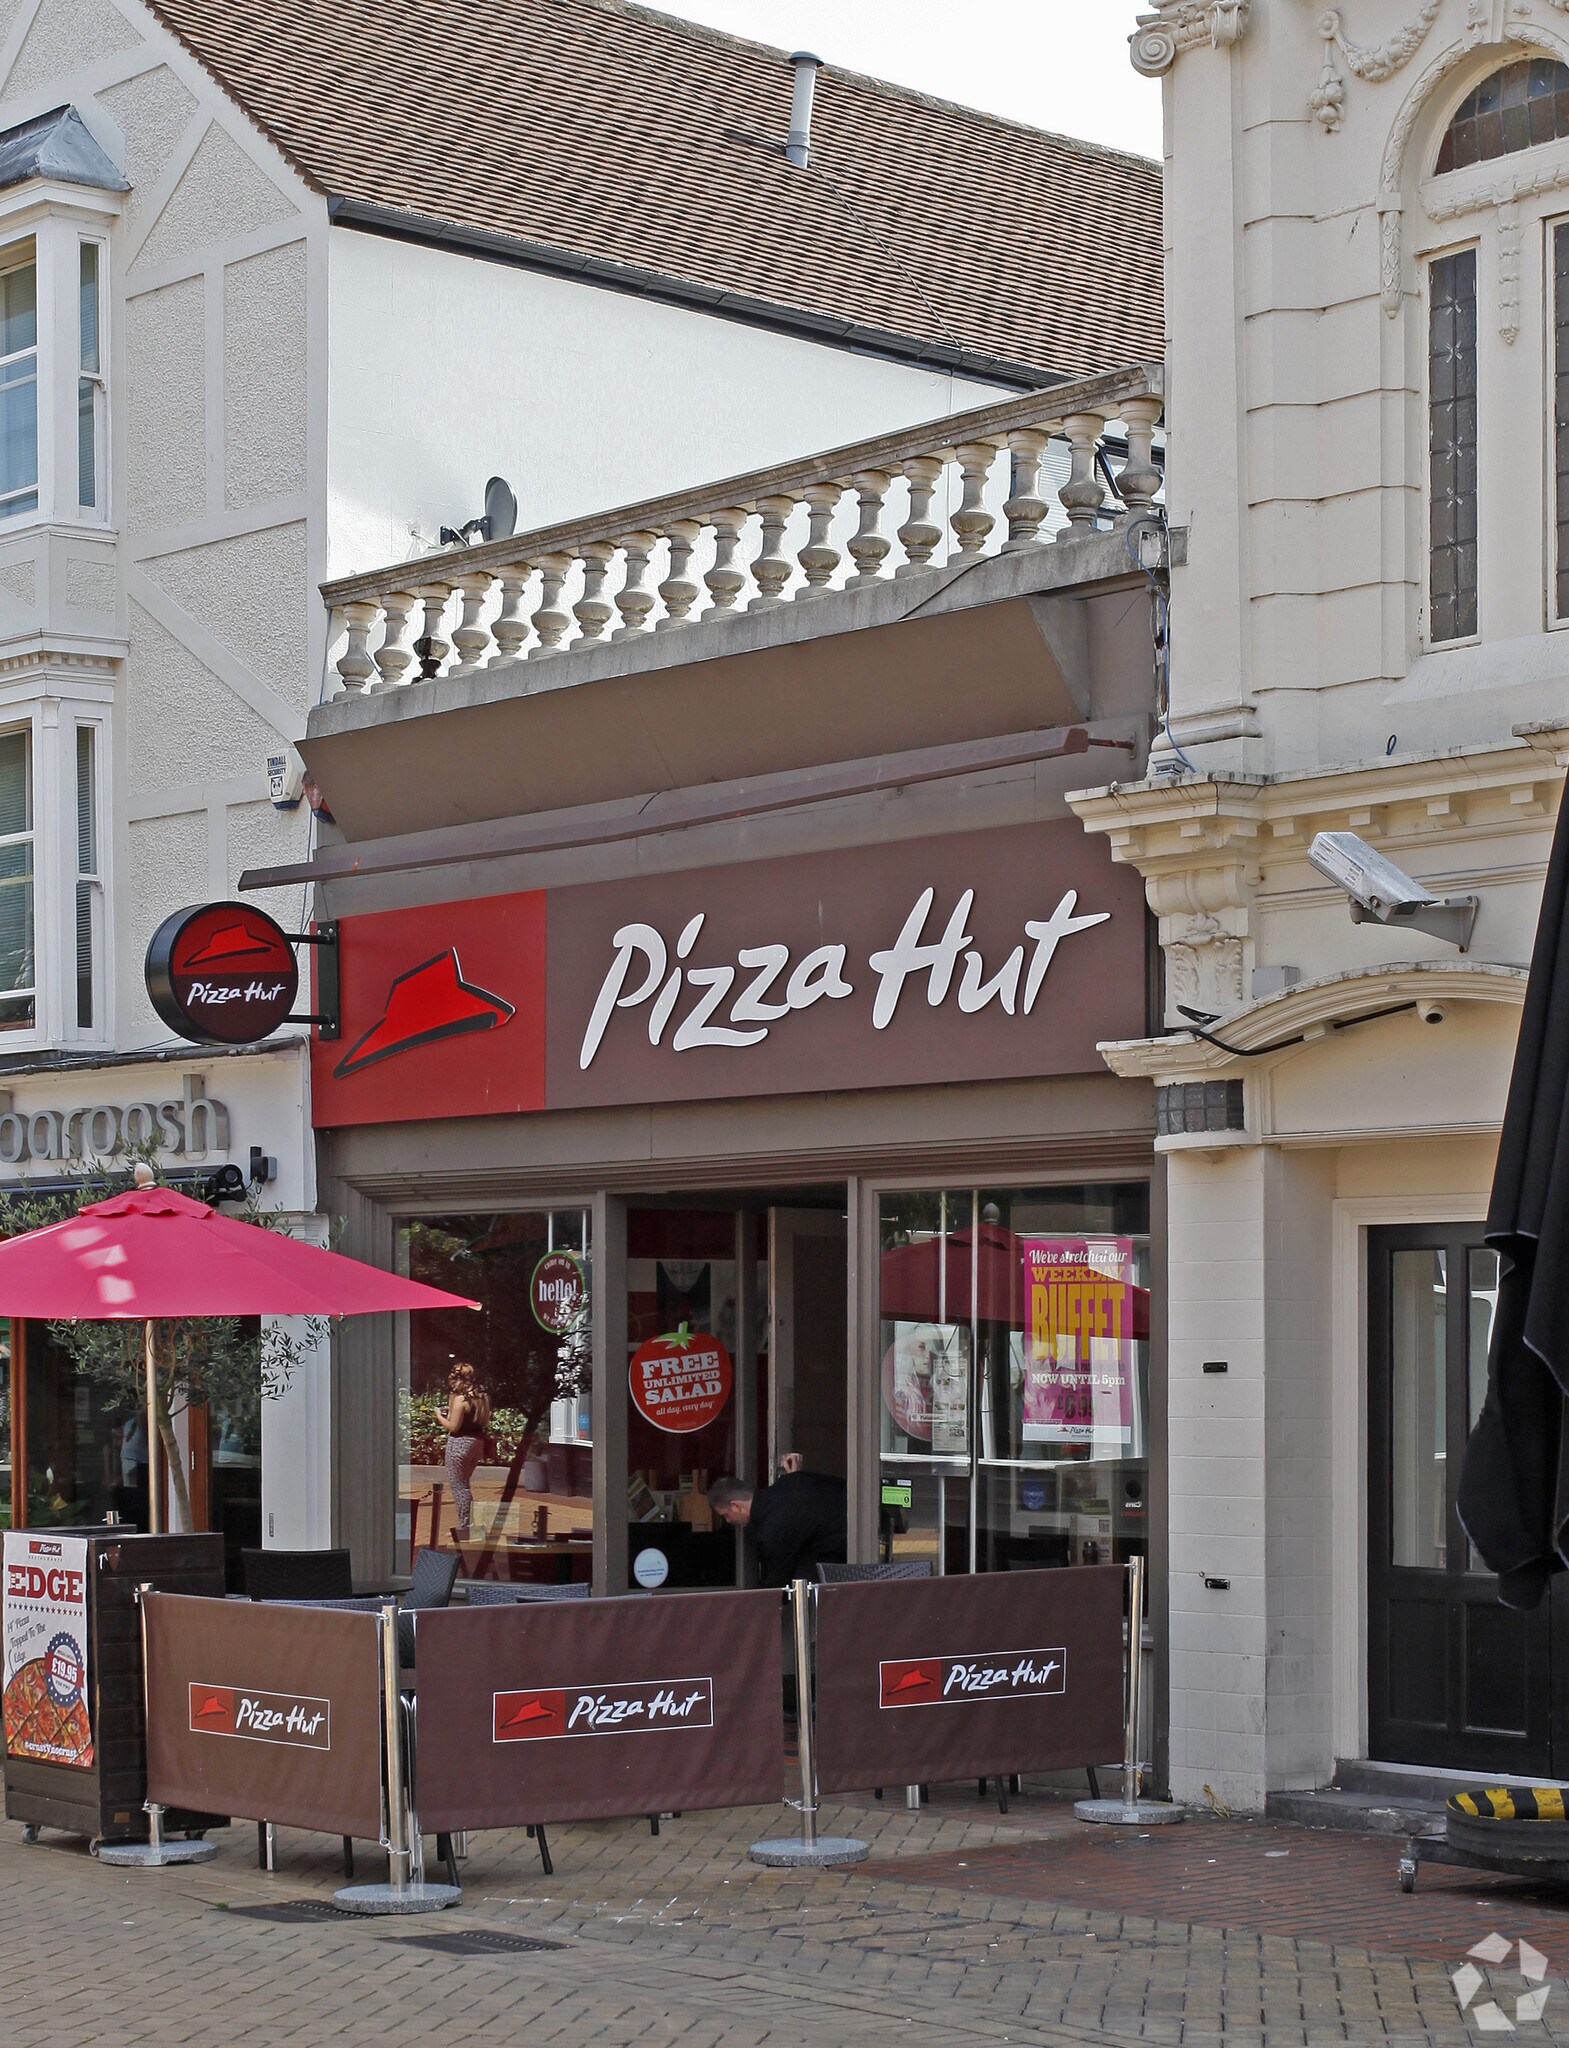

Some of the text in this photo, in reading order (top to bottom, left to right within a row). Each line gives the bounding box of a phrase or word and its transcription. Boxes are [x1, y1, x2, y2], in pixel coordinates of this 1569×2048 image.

[579, 886, 1111, 1070] Pizza Hut
[187, 981, 287, 1007] Pizza Hut
[1029, 1249, 1127, 1264] We've stretched our
[1031, 1265, 1125, 1282] WEEKDAY
[538, 1278, 577, 1302] hello!
[1031, 1283, 1126, 1361] BUFFET
[641, 1351, 719, 1379] FREE
[643, 1370, 720, 1389] UNLIMITED
[1032, 1374, 1058, 1385] NOW
[1061, 1374, 1100, 1386] UNTIL
[645, 1381, 722, 1405] SALAD
[8, 1564, 83, 1604] EDGE
[10, 1631, 29, 1649] Topped
[28, 1626, 36, 1638] To
[51, 1657, 78, 1683] £19.95
[944, 1659, 1061, 1696] Pizza Hut
[235, 1698, 326, 1736] Pizza Hut
[567, 1689, 706, 1729] Pizza Hut
